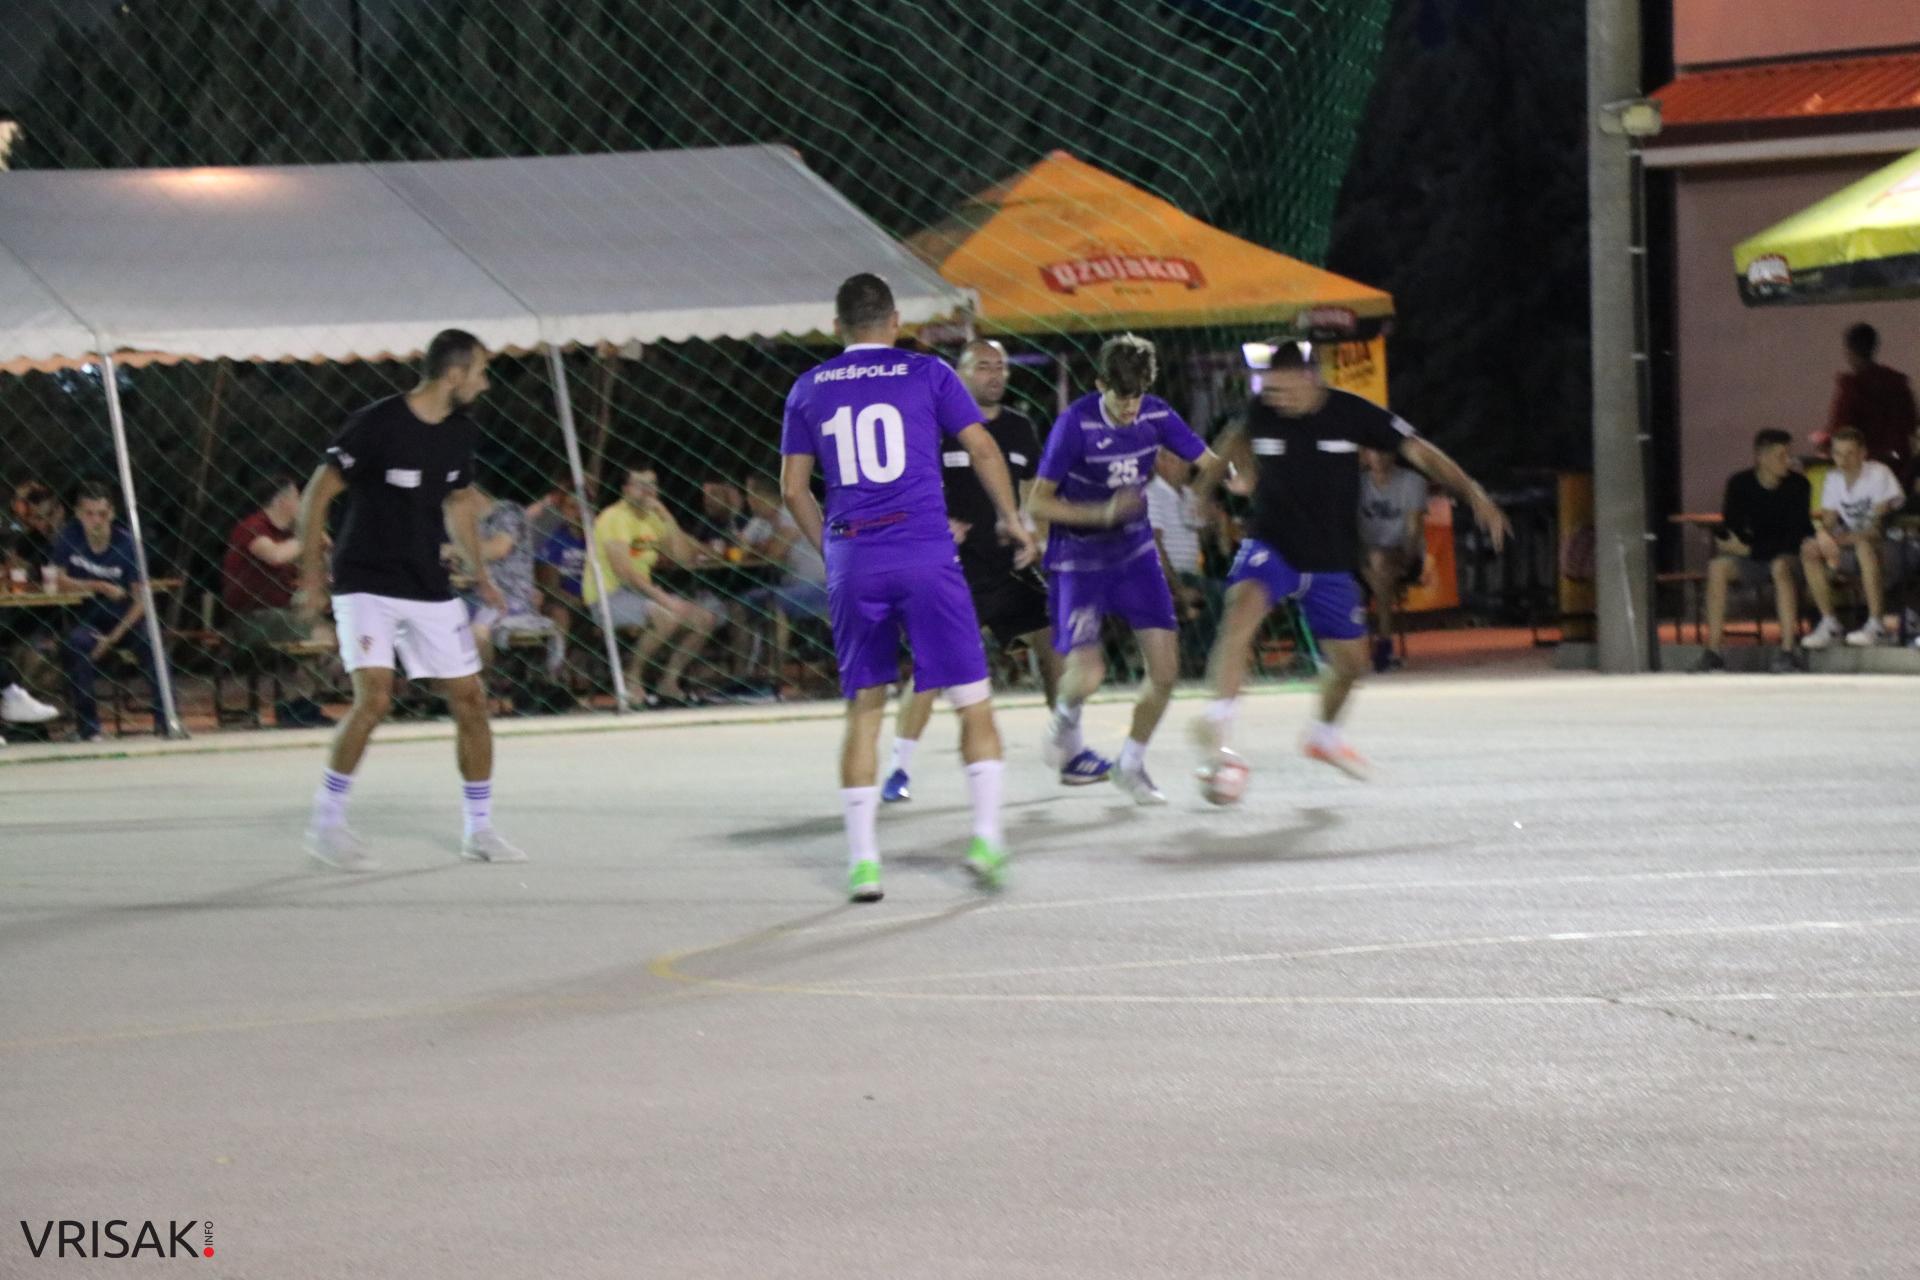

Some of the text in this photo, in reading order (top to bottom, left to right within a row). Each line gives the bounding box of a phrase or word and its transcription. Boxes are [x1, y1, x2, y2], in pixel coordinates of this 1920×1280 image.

[814, 363, 908, 384] KNEŠPOLJE
[821, 403, 906, 486] 10
[1106, 457, 1139, 489] 25
